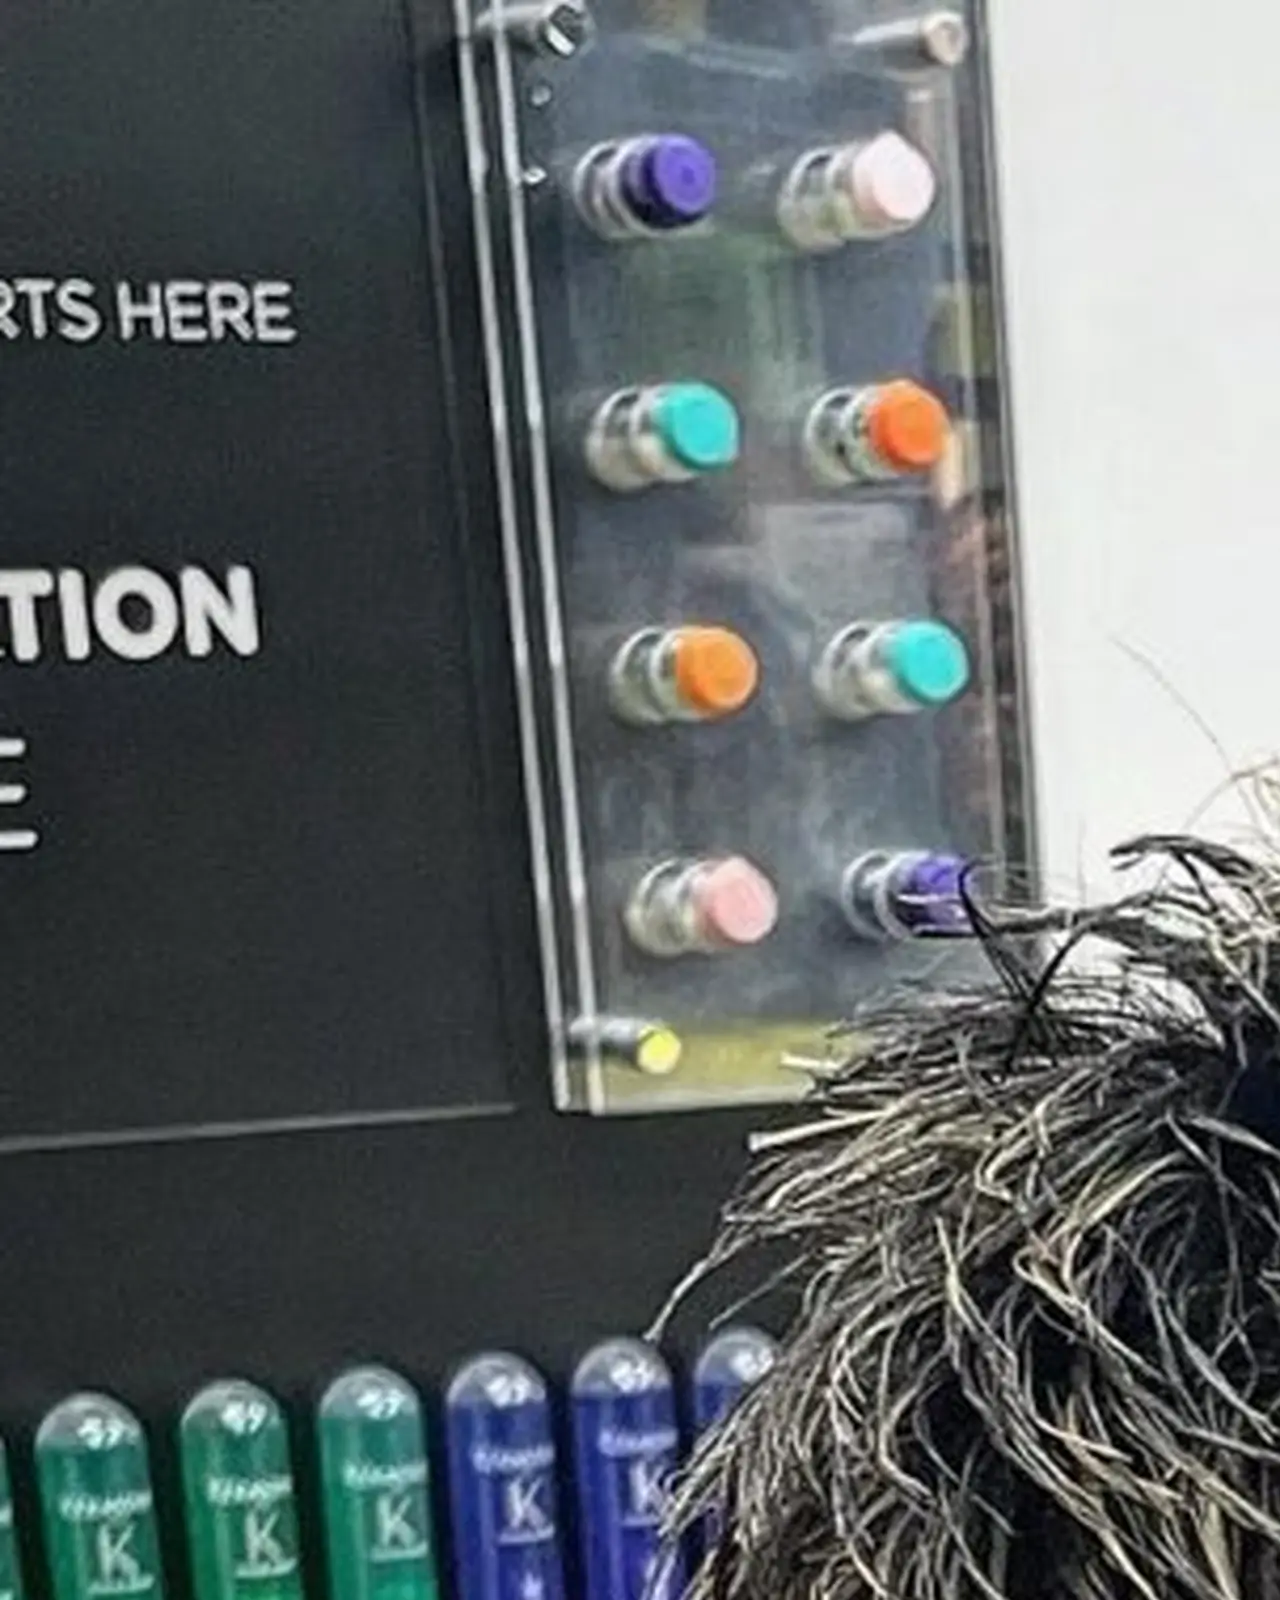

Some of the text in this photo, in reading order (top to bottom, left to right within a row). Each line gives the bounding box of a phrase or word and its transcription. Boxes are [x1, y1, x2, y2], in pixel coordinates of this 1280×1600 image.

[117, 279, 297, 342] HERE
[377, 1494, 418, 1549] K
[507, 1474, 548, 1531] K
[97, 1520, 141, 1586] K
[243, 1506, 287, 1568] K
